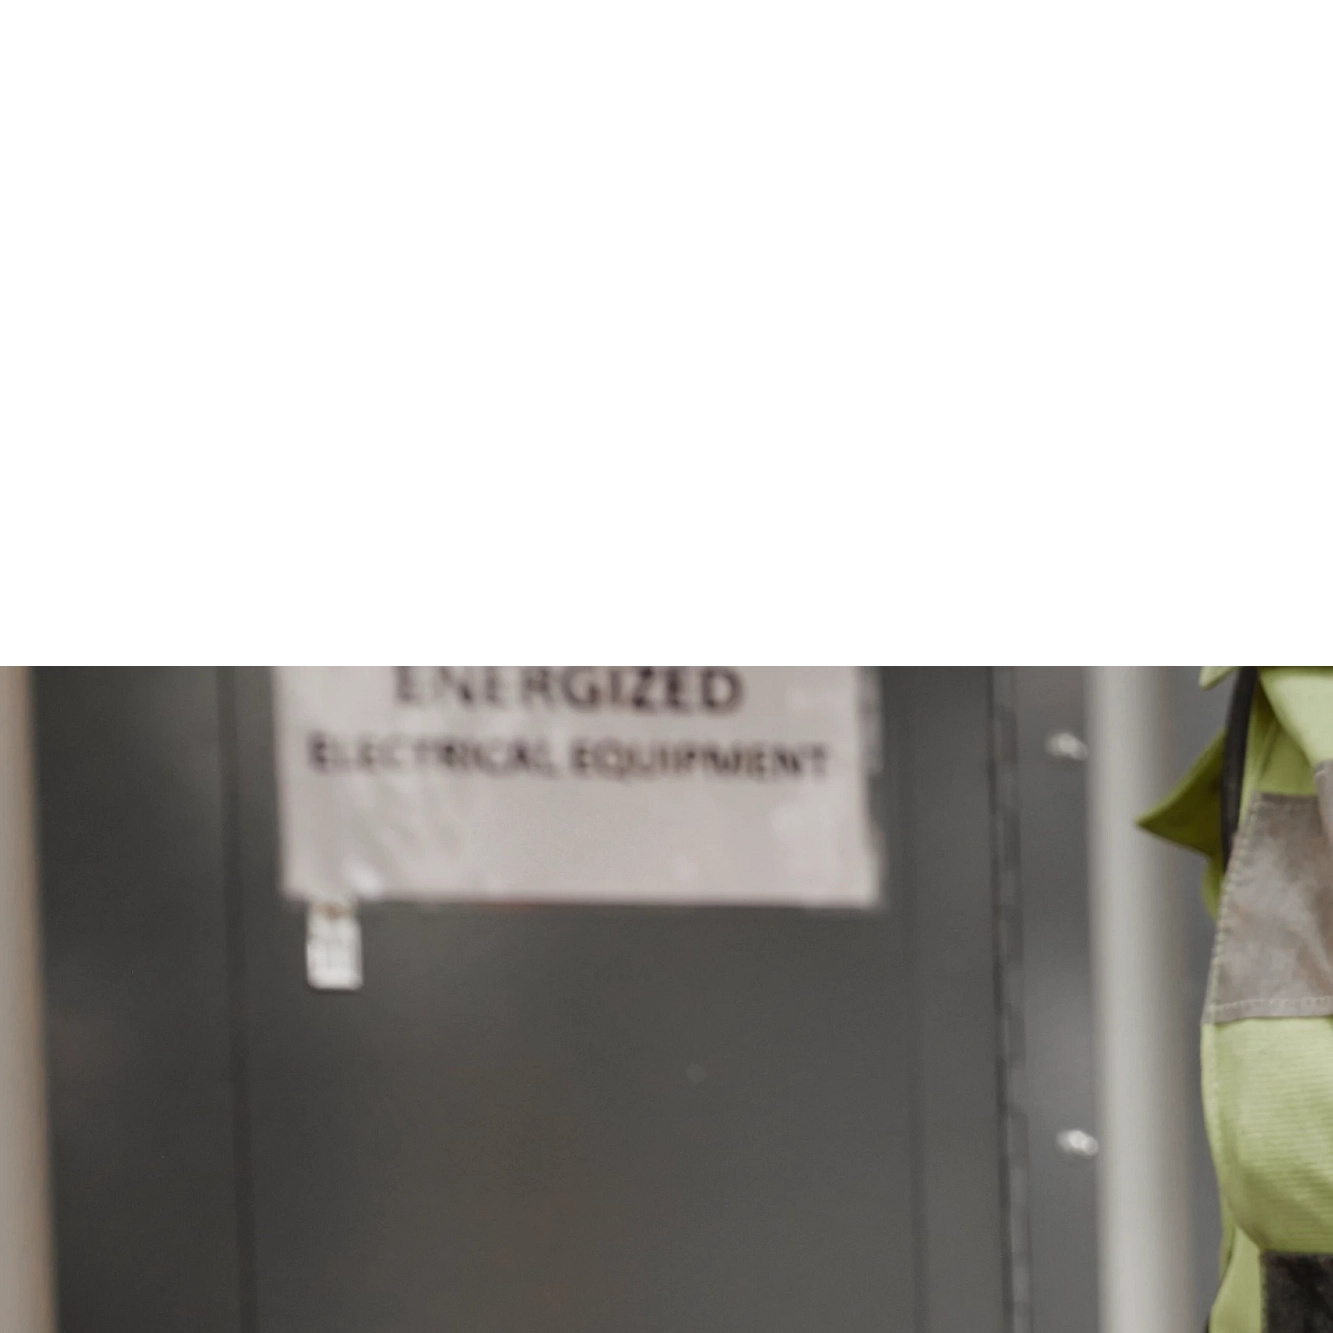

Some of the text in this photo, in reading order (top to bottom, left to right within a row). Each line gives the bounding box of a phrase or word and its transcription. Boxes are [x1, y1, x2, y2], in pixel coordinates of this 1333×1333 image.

[395, 664, 745, 716] ENERGIZED
[307, 732, 827, 785] ELECTRICAL EQUIPMENT
